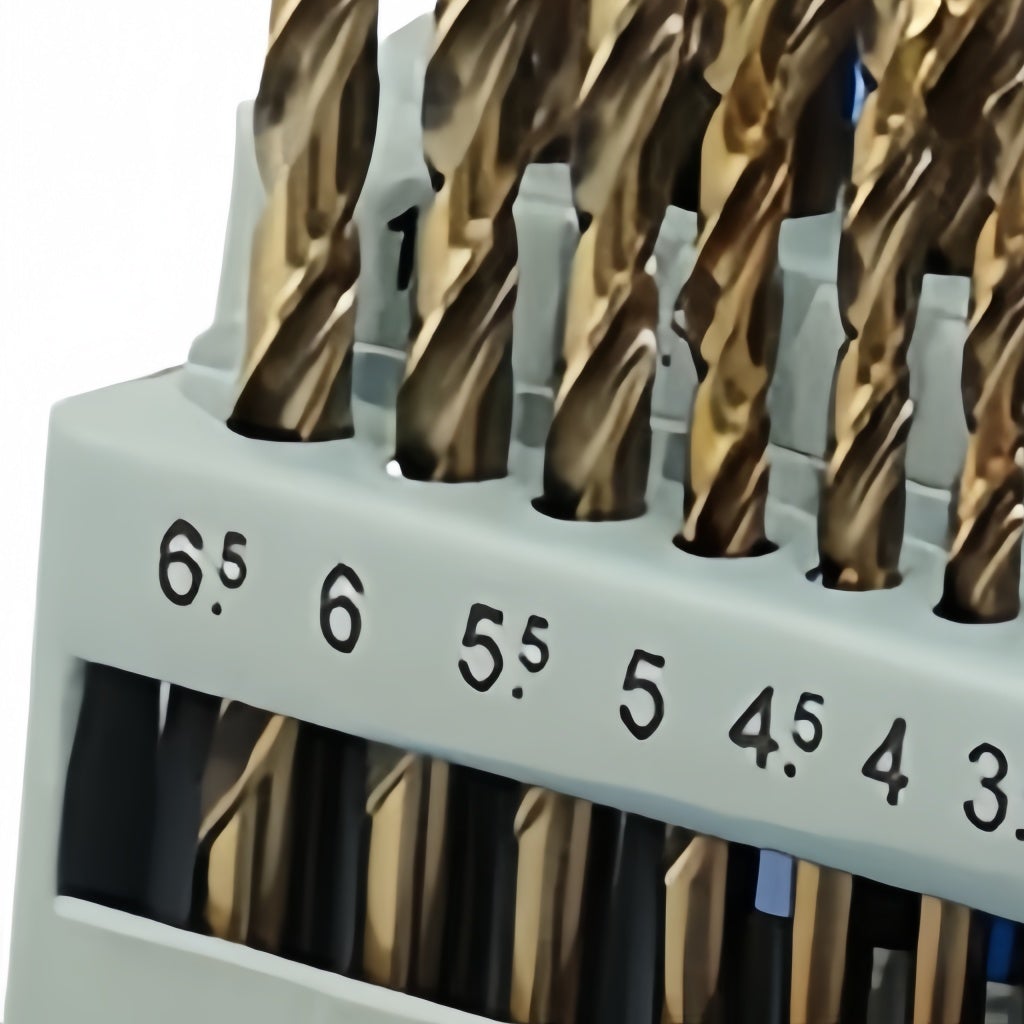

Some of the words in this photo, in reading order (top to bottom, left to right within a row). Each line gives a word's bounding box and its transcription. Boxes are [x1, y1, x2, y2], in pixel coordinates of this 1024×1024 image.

[158, 518, 247, 616] 6.5
[319, 562, 365, 654] 6
[457, 602, 550, 700] 5.5
[619, 648, 666, 741] 5
[728, 685, 825, 779] 4.5
[861, 717, 909, 806] 4
